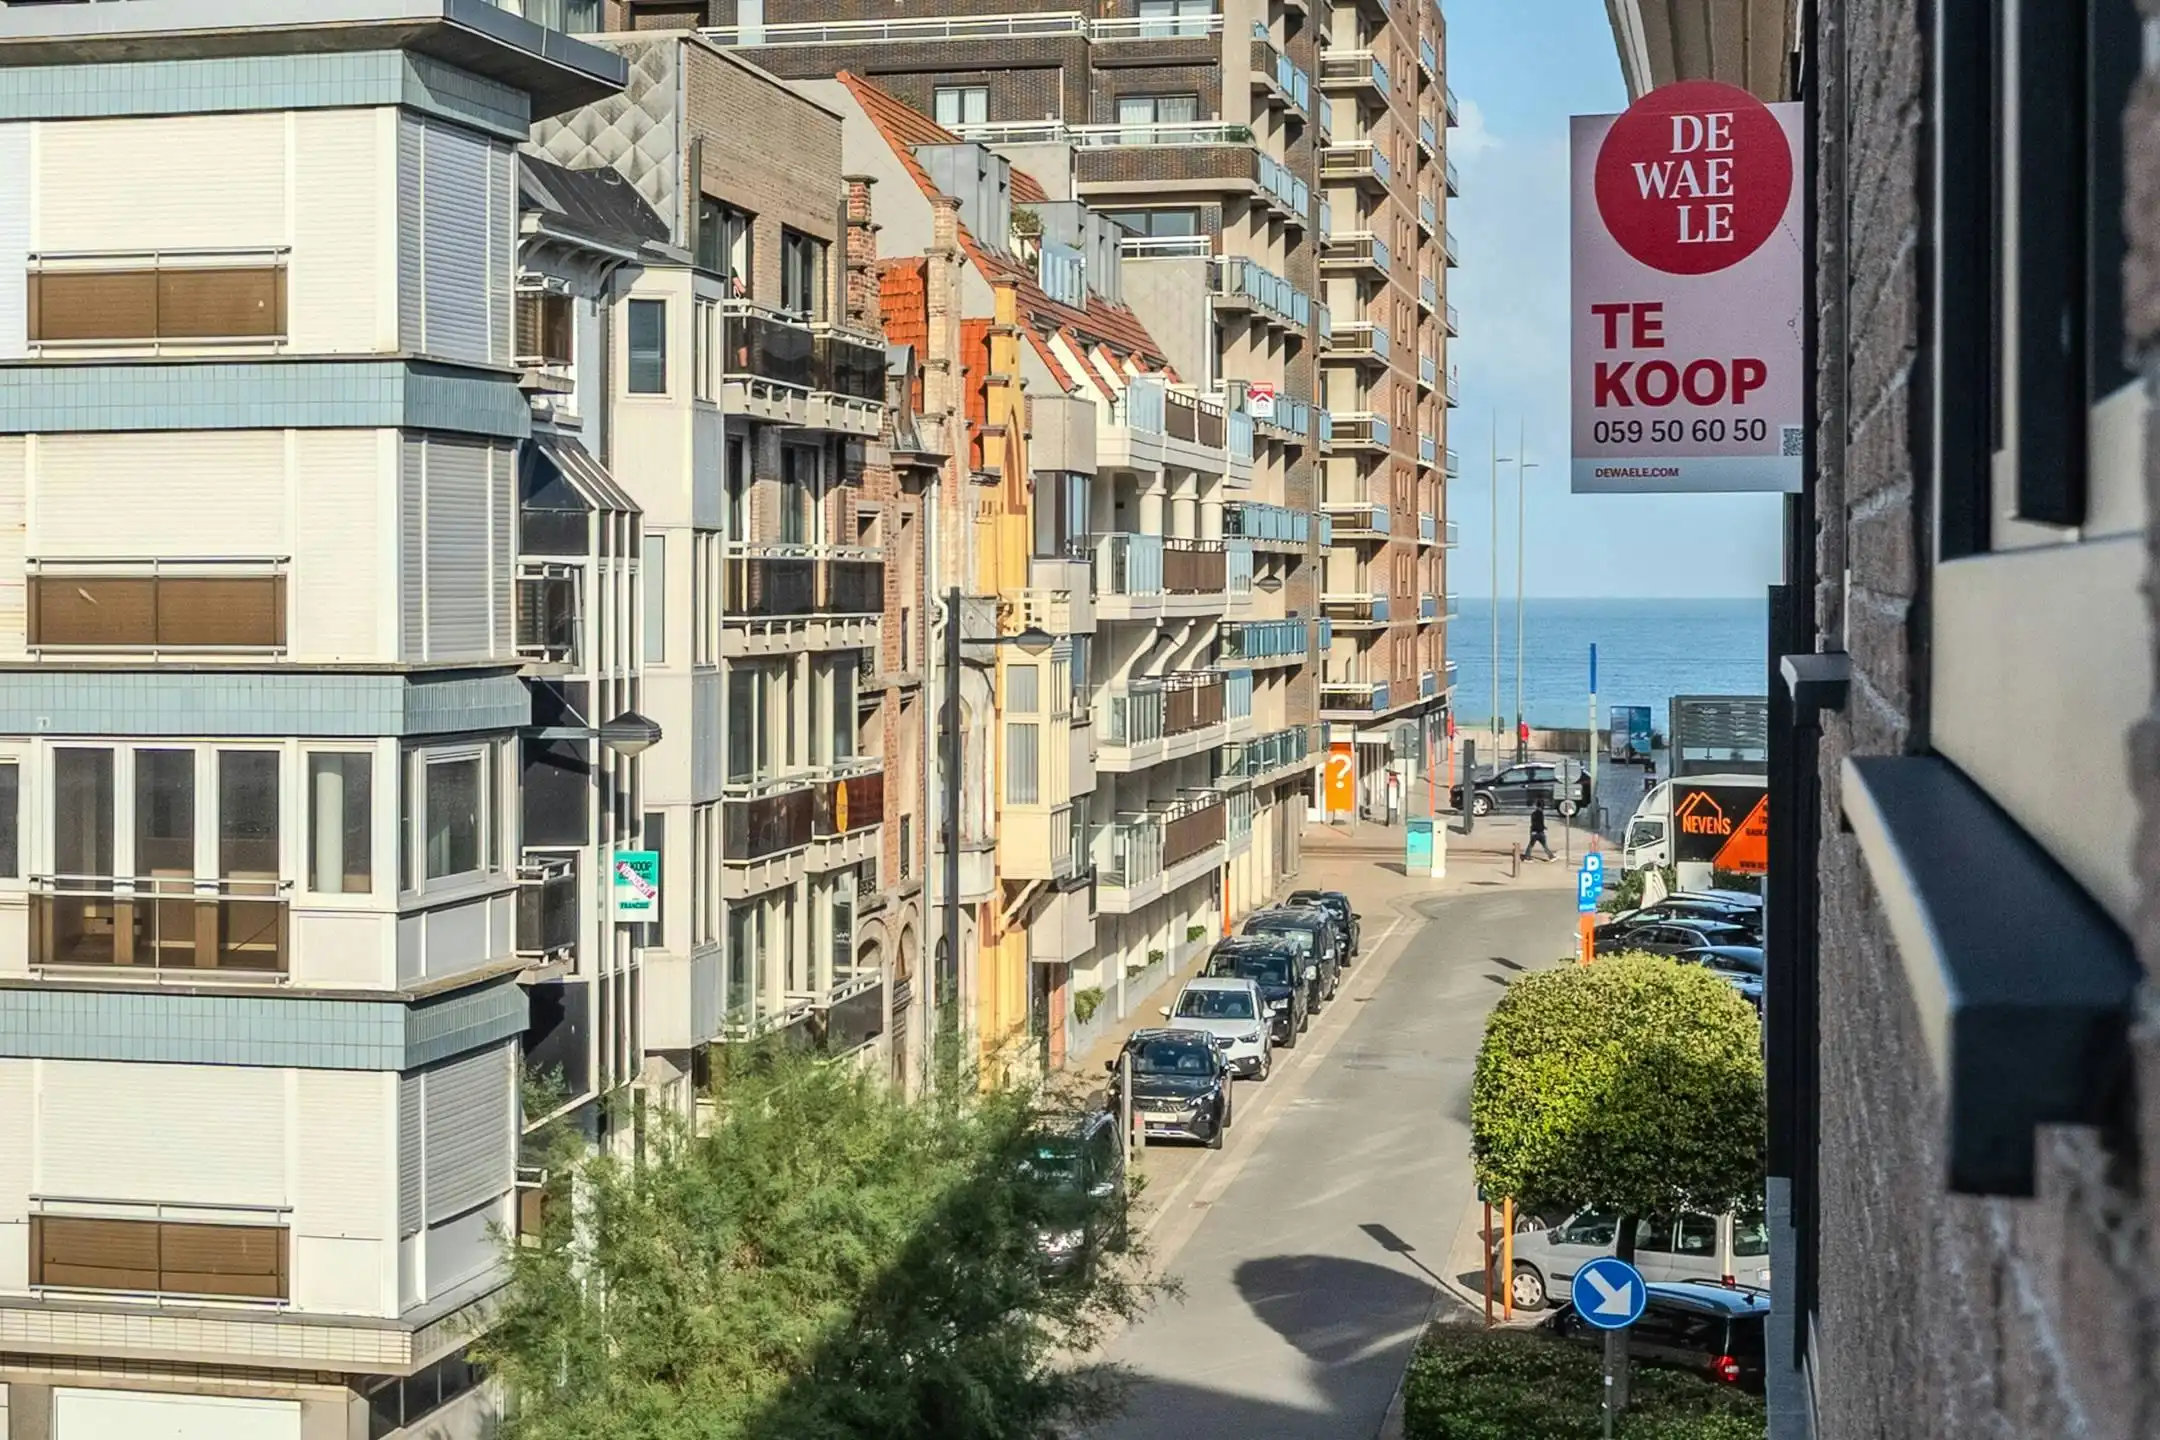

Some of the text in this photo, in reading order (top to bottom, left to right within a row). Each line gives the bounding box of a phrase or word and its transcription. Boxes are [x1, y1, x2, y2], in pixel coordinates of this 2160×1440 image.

[1669, 112, 1734, 154] DE
[1631, 158, 1734, 200] WAE
[1676, 203, 1734, 244] LE
[1591, 302, 1665, 349] TE
[1594, 358, 1768, 407] KOOP
[1593, 418, 1767, 444] 059 50 60 50
[1595, 467, 1680, 478] DEWAELE.COM
[1682, 815, 1731, 835] NEVENS
